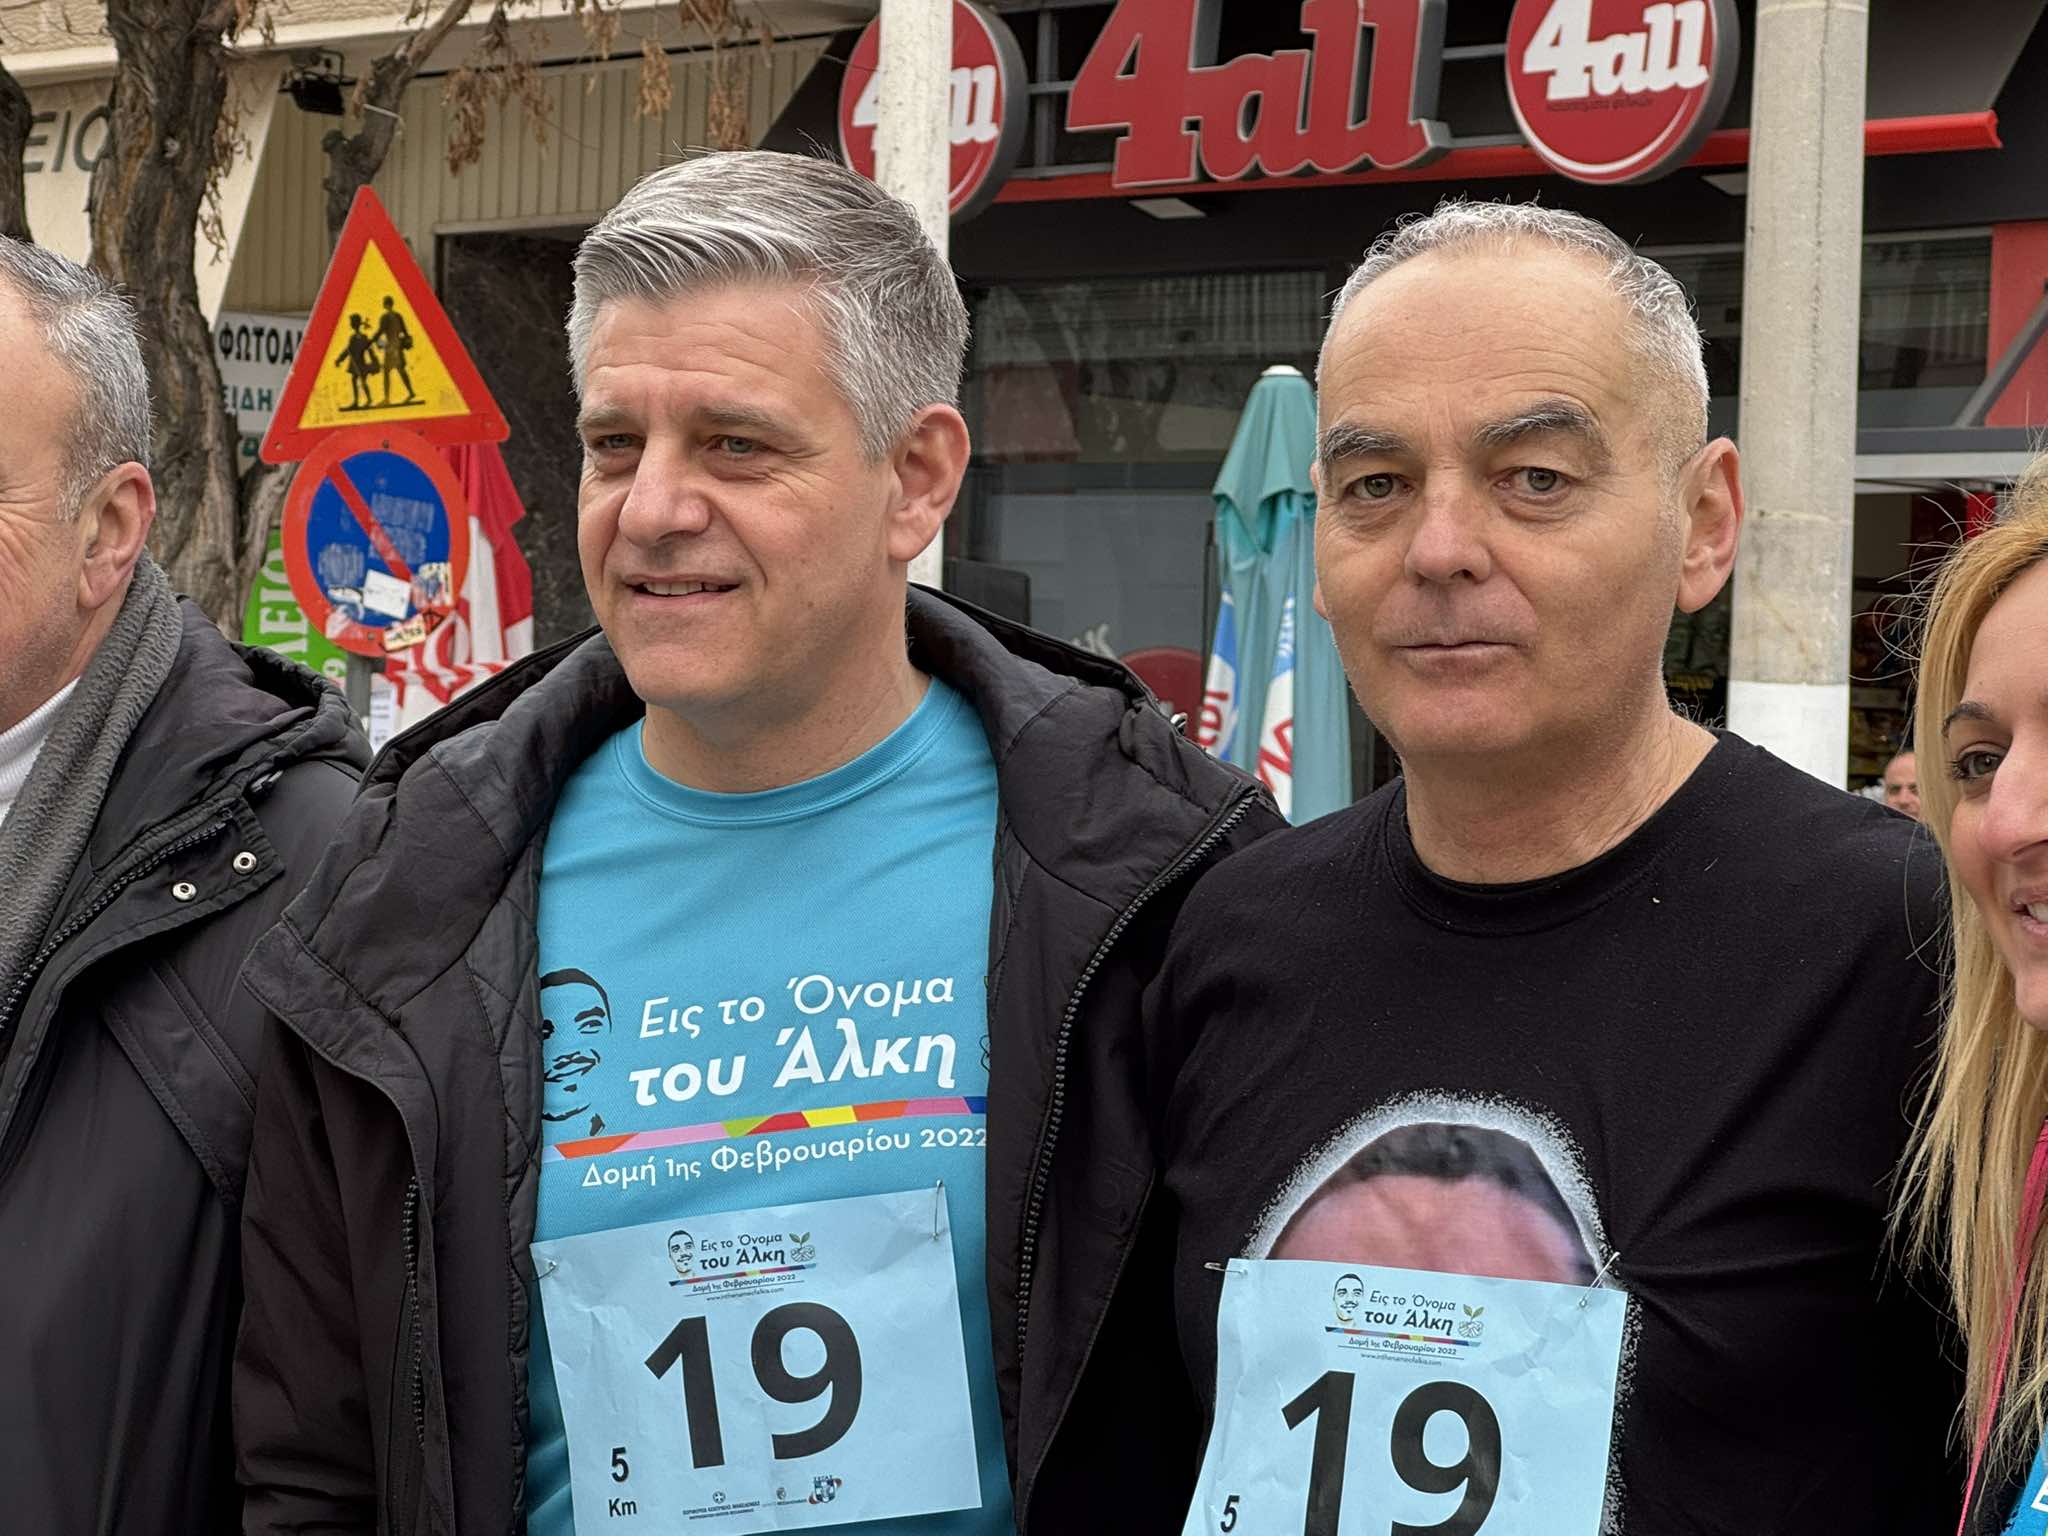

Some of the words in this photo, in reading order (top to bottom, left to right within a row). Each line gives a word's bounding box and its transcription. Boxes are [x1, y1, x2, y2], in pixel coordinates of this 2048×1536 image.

[1522, 0, 1710, 101] 4all
[1066, 0, 1446, 188] 4all
[219, 322, 303, 365] ΦΩΤΟΑ
[639, 996, 704, 1039] Εις
[717, 996, 766, 1025] το
[786, 974, 954, 1017] Όνομα
[628, 1055, 746, 1107] του
[772, 1017, 956, 1089] Άλκη
[581, 1155, 657, 1190] Δομή
[710, 1127, 911, 1175] Φεβρουαρίου
[920, 1126, 987, 1149] 2022
[700, 1239, 718, 1252] Εις
[720, 1239, 734, 1249] το
[737, 1233, 783, 1247] Όνομα
[700, 1255, 730, 1270] του
[736, 1246, 786, 1265] Άλκη
[1364, 1310, 1398, 1325] του
[1403, 1309, 1454, 1336] Άλκη
[1369, 1290, 1390, 1305] Εις
[1393, 1296, 1407, 1306] το
[1411, 1294, 1456, 1313] Όνομα
[644, 1301, 863, 1470] 19
[610, 1446, 630, 1483] 5
[1281, 1370, 1502, 1536] 19
[608, 1498, 637, 1518] Km
[1220, 1494, 1240, 1533] 5
